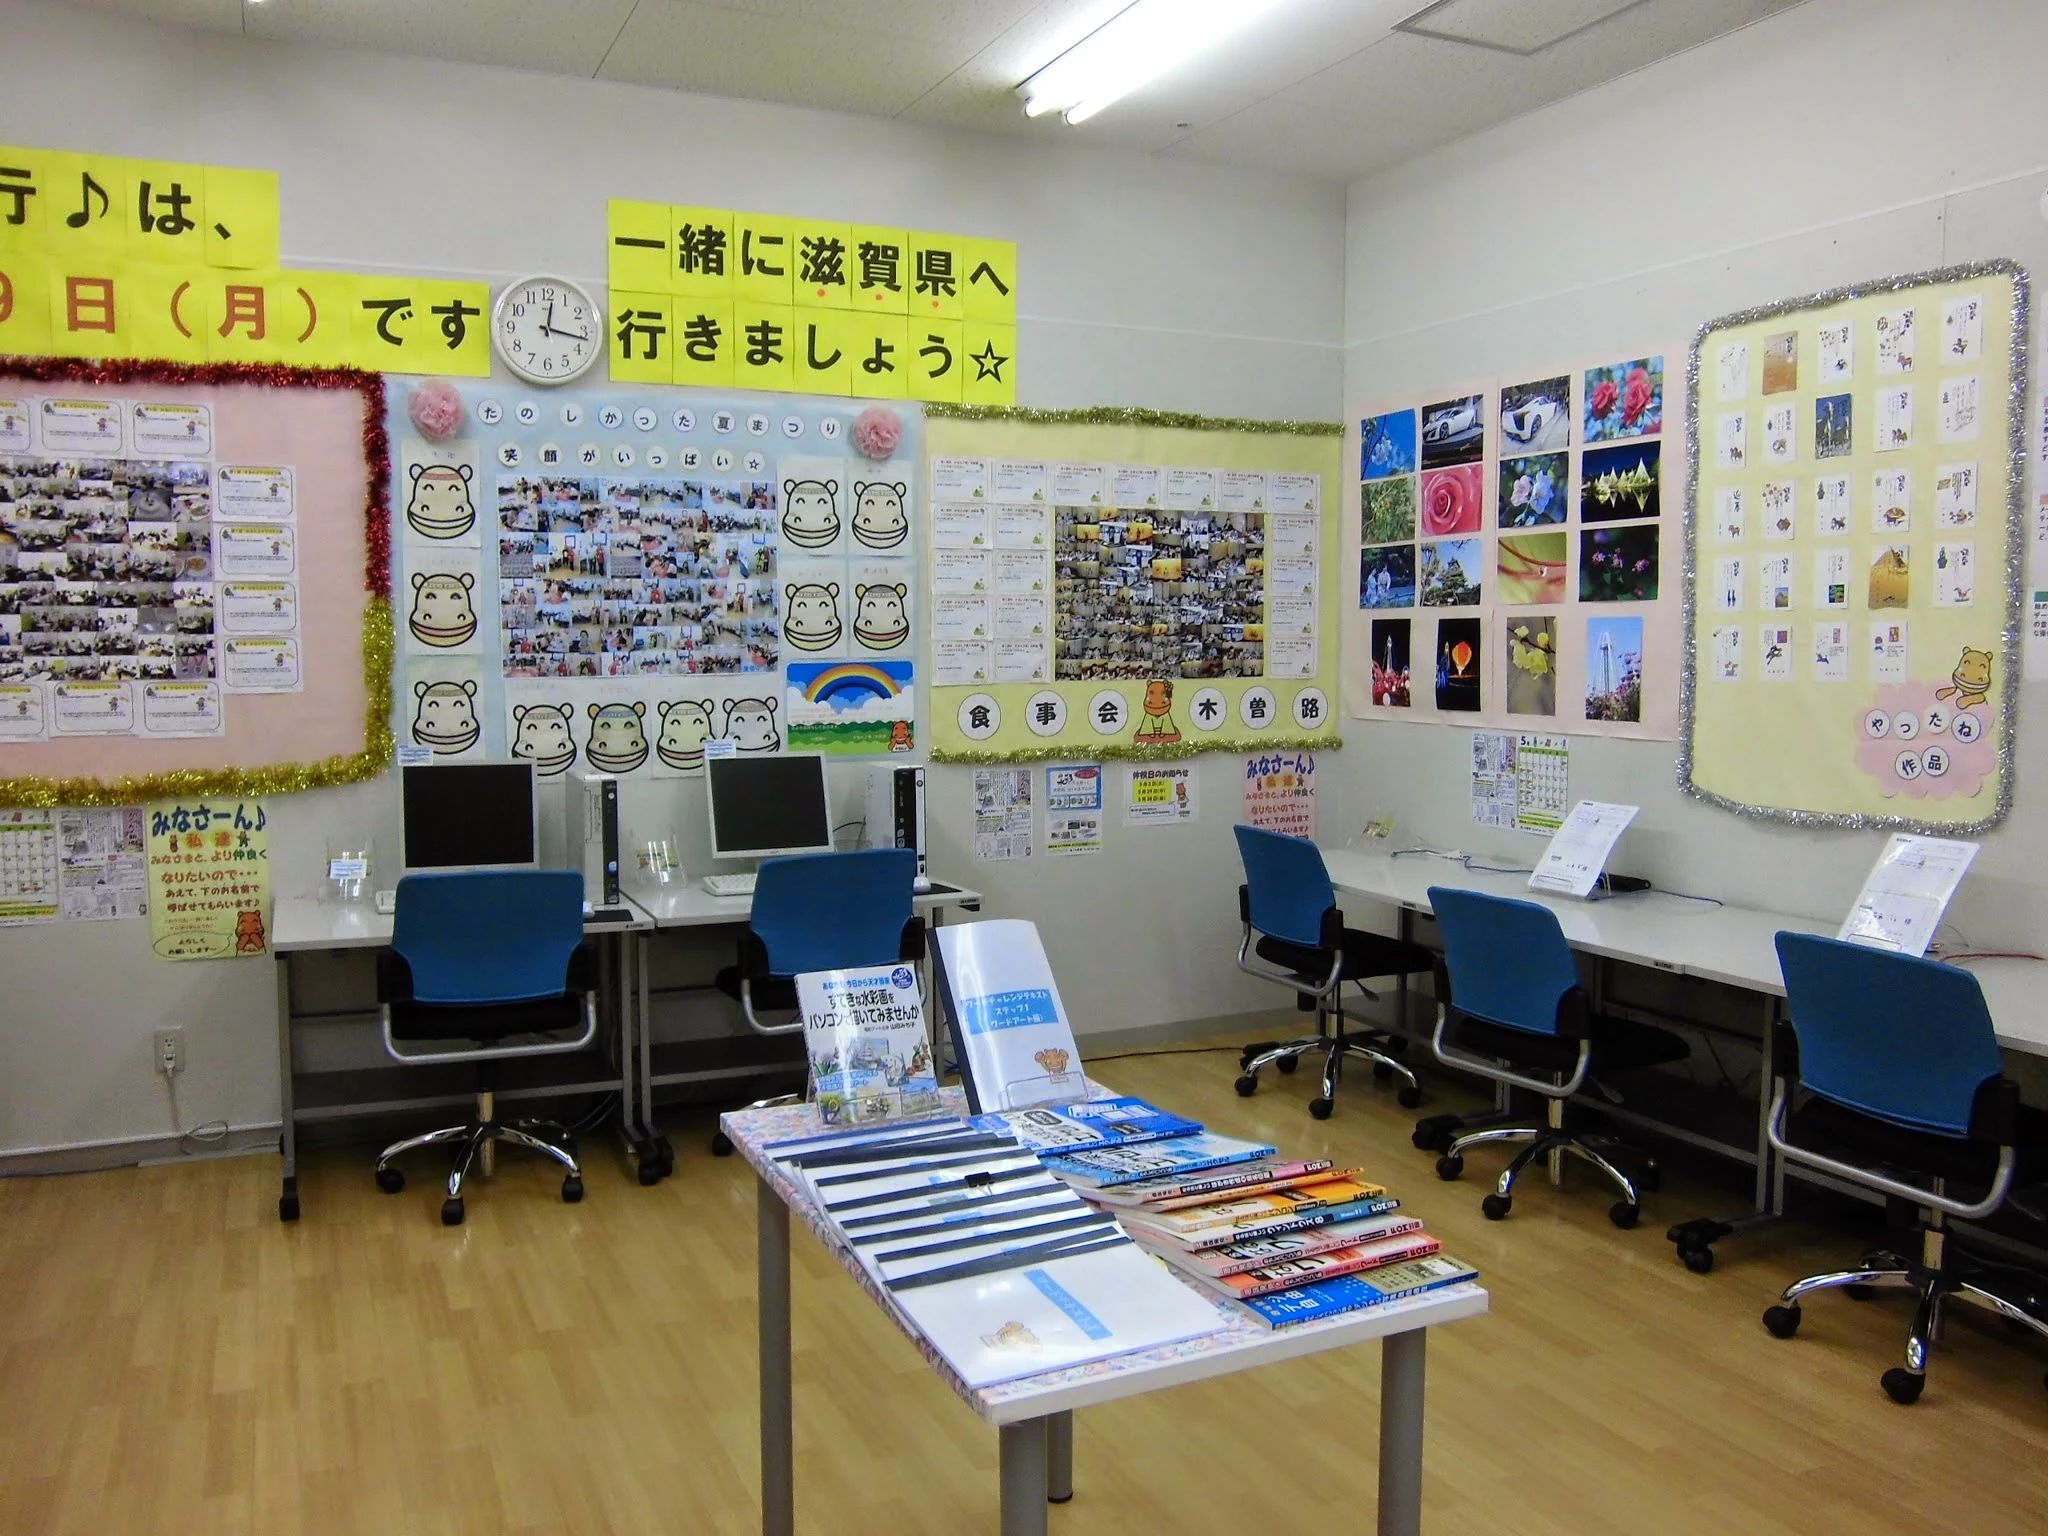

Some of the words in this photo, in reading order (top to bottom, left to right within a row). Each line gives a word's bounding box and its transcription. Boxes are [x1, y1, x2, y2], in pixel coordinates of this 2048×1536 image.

[615, 223, 1009, 297] 一緒に滋賀県へ
[526, 291, 536, 304] 11
[543, 287, 555, 301] 12
[563, 294, 568, 307] 1
[512, 303, 525, 317] 10
[574, 307, 582, 320] 2
[506, 321, 516, 334] 9
[580, 325, 588, 338] 3
[513, 339, 522, 352] 8
[573, 343, 581, 355] 4
[528, 352, 536, 365] 7
[543, 357, 552, 371] 6
[561, 355, 570, 368] 5
[484, 407, 836, 436] たのしかった夏まつり
[968, 701, 1118, 729] 食事会
[1199, 698, 1319, 720] 木曽路
[1871, 713, 1972, 737] やったね
[1902, 755, 1942, 774] 作品
